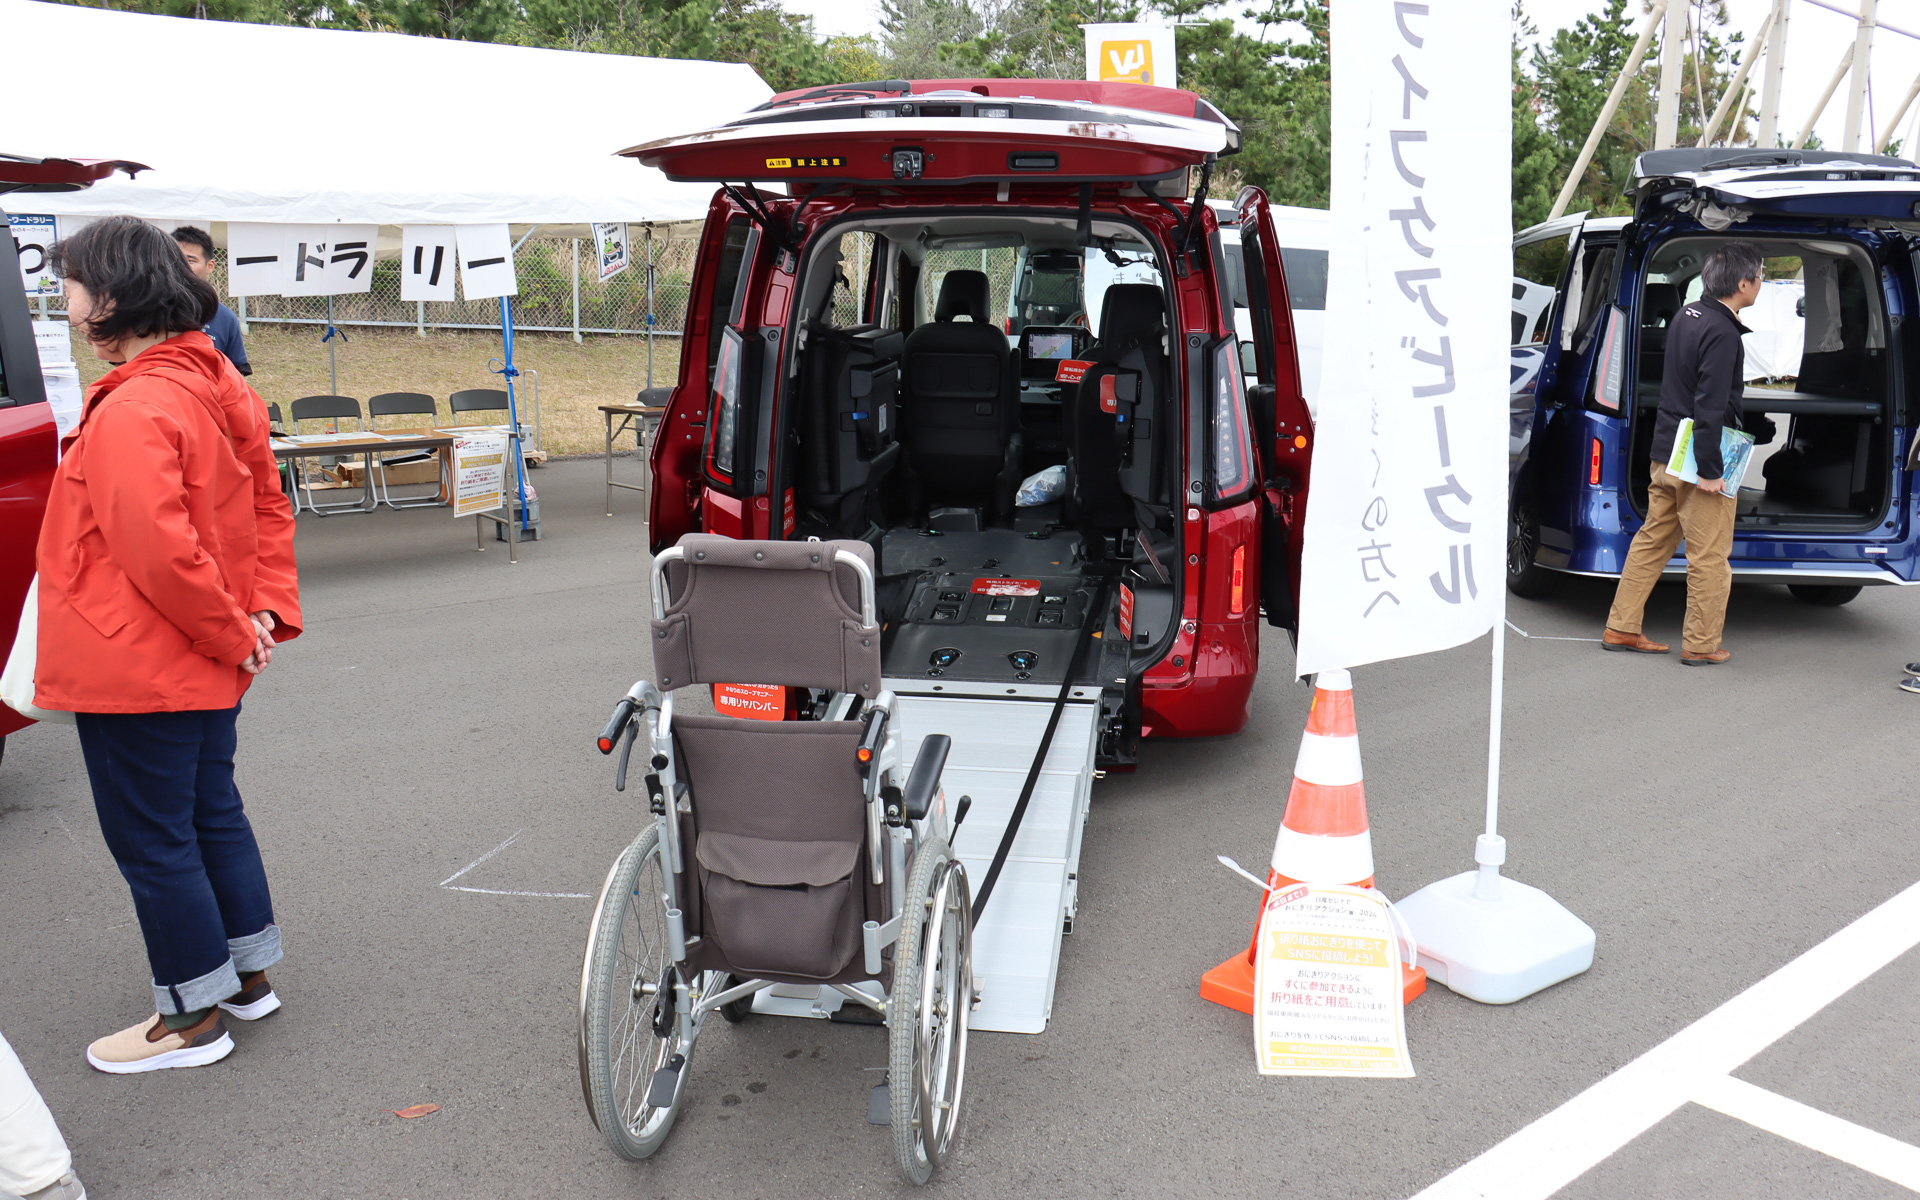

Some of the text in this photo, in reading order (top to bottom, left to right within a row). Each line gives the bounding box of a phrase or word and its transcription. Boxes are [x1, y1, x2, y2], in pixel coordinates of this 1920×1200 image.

[720, 695, 779, 711] 専用リヤバンパー
[1279, 933, 1382, 951] 折り紙おにぎりを使って
[1287, 948, 1374, 964] SNSに投稿しよう!
[1297, 969, 1362, 982] おにぎりアクションに
[1284, 979, 1374, 995] すぐに参加できるように
[1270, 992, 1387, 1010] 折り紙をご用意しています!
